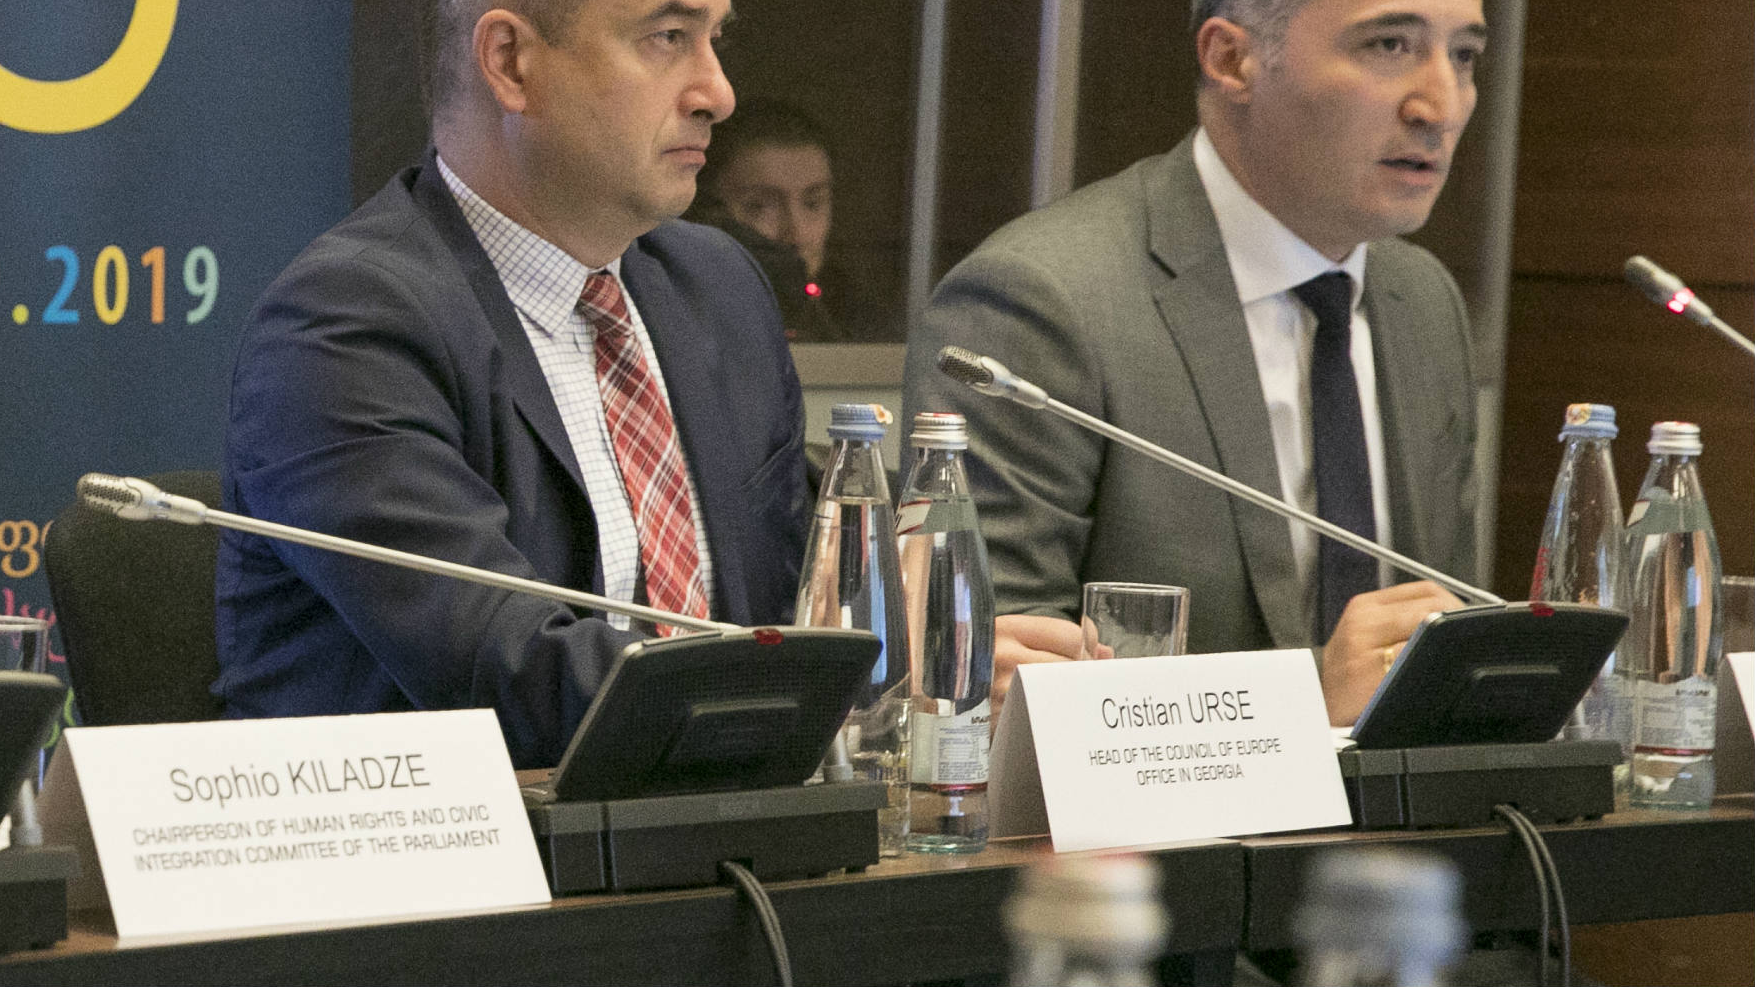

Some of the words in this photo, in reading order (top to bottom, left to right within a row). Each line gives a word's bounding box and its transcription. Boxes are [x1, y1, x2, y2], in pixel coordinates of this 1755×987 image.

[1102, 695, 1182, 729] Cristian
[1187, 690, 1254, 723] URSE
[1089, 748, 1120, 765] HEAD
[1124, 747, 1138, 763] OF
[1141, 746, 1162, 762] THE
[1166, 743, 1216, 761] COUNCIL
[1218, 741, 1233, 757] OF
[1236, 738, 1281, 755] EUROPE
[170, 763, 280, 809] Sophio
[287, 754, 430, 794] KILADZE
[1137, 768, 1176, 786] OFFICE
[1179, 768, 1191, 782] IN
[1194, 764, 1245, 781] GEORGIA
[133, 822, 251, 846] CHAIRPERSON
[256, 819, 277, 838] OF
[283, 815, 344, 835] HUMAN
[350, 810, 406, 830] RIGHTS
[412, 808, 445, 825] AND
[449, 805, 489, 823] CIVIC
[134, 849, 242, 871] INTEGRATION
[246, 842, 338, 864] COMMITTEE
[344, 839, 364, 857] OF
[370, 837, 400, 854] THE
[404, 829, 500, 852] PARLIAMENT
